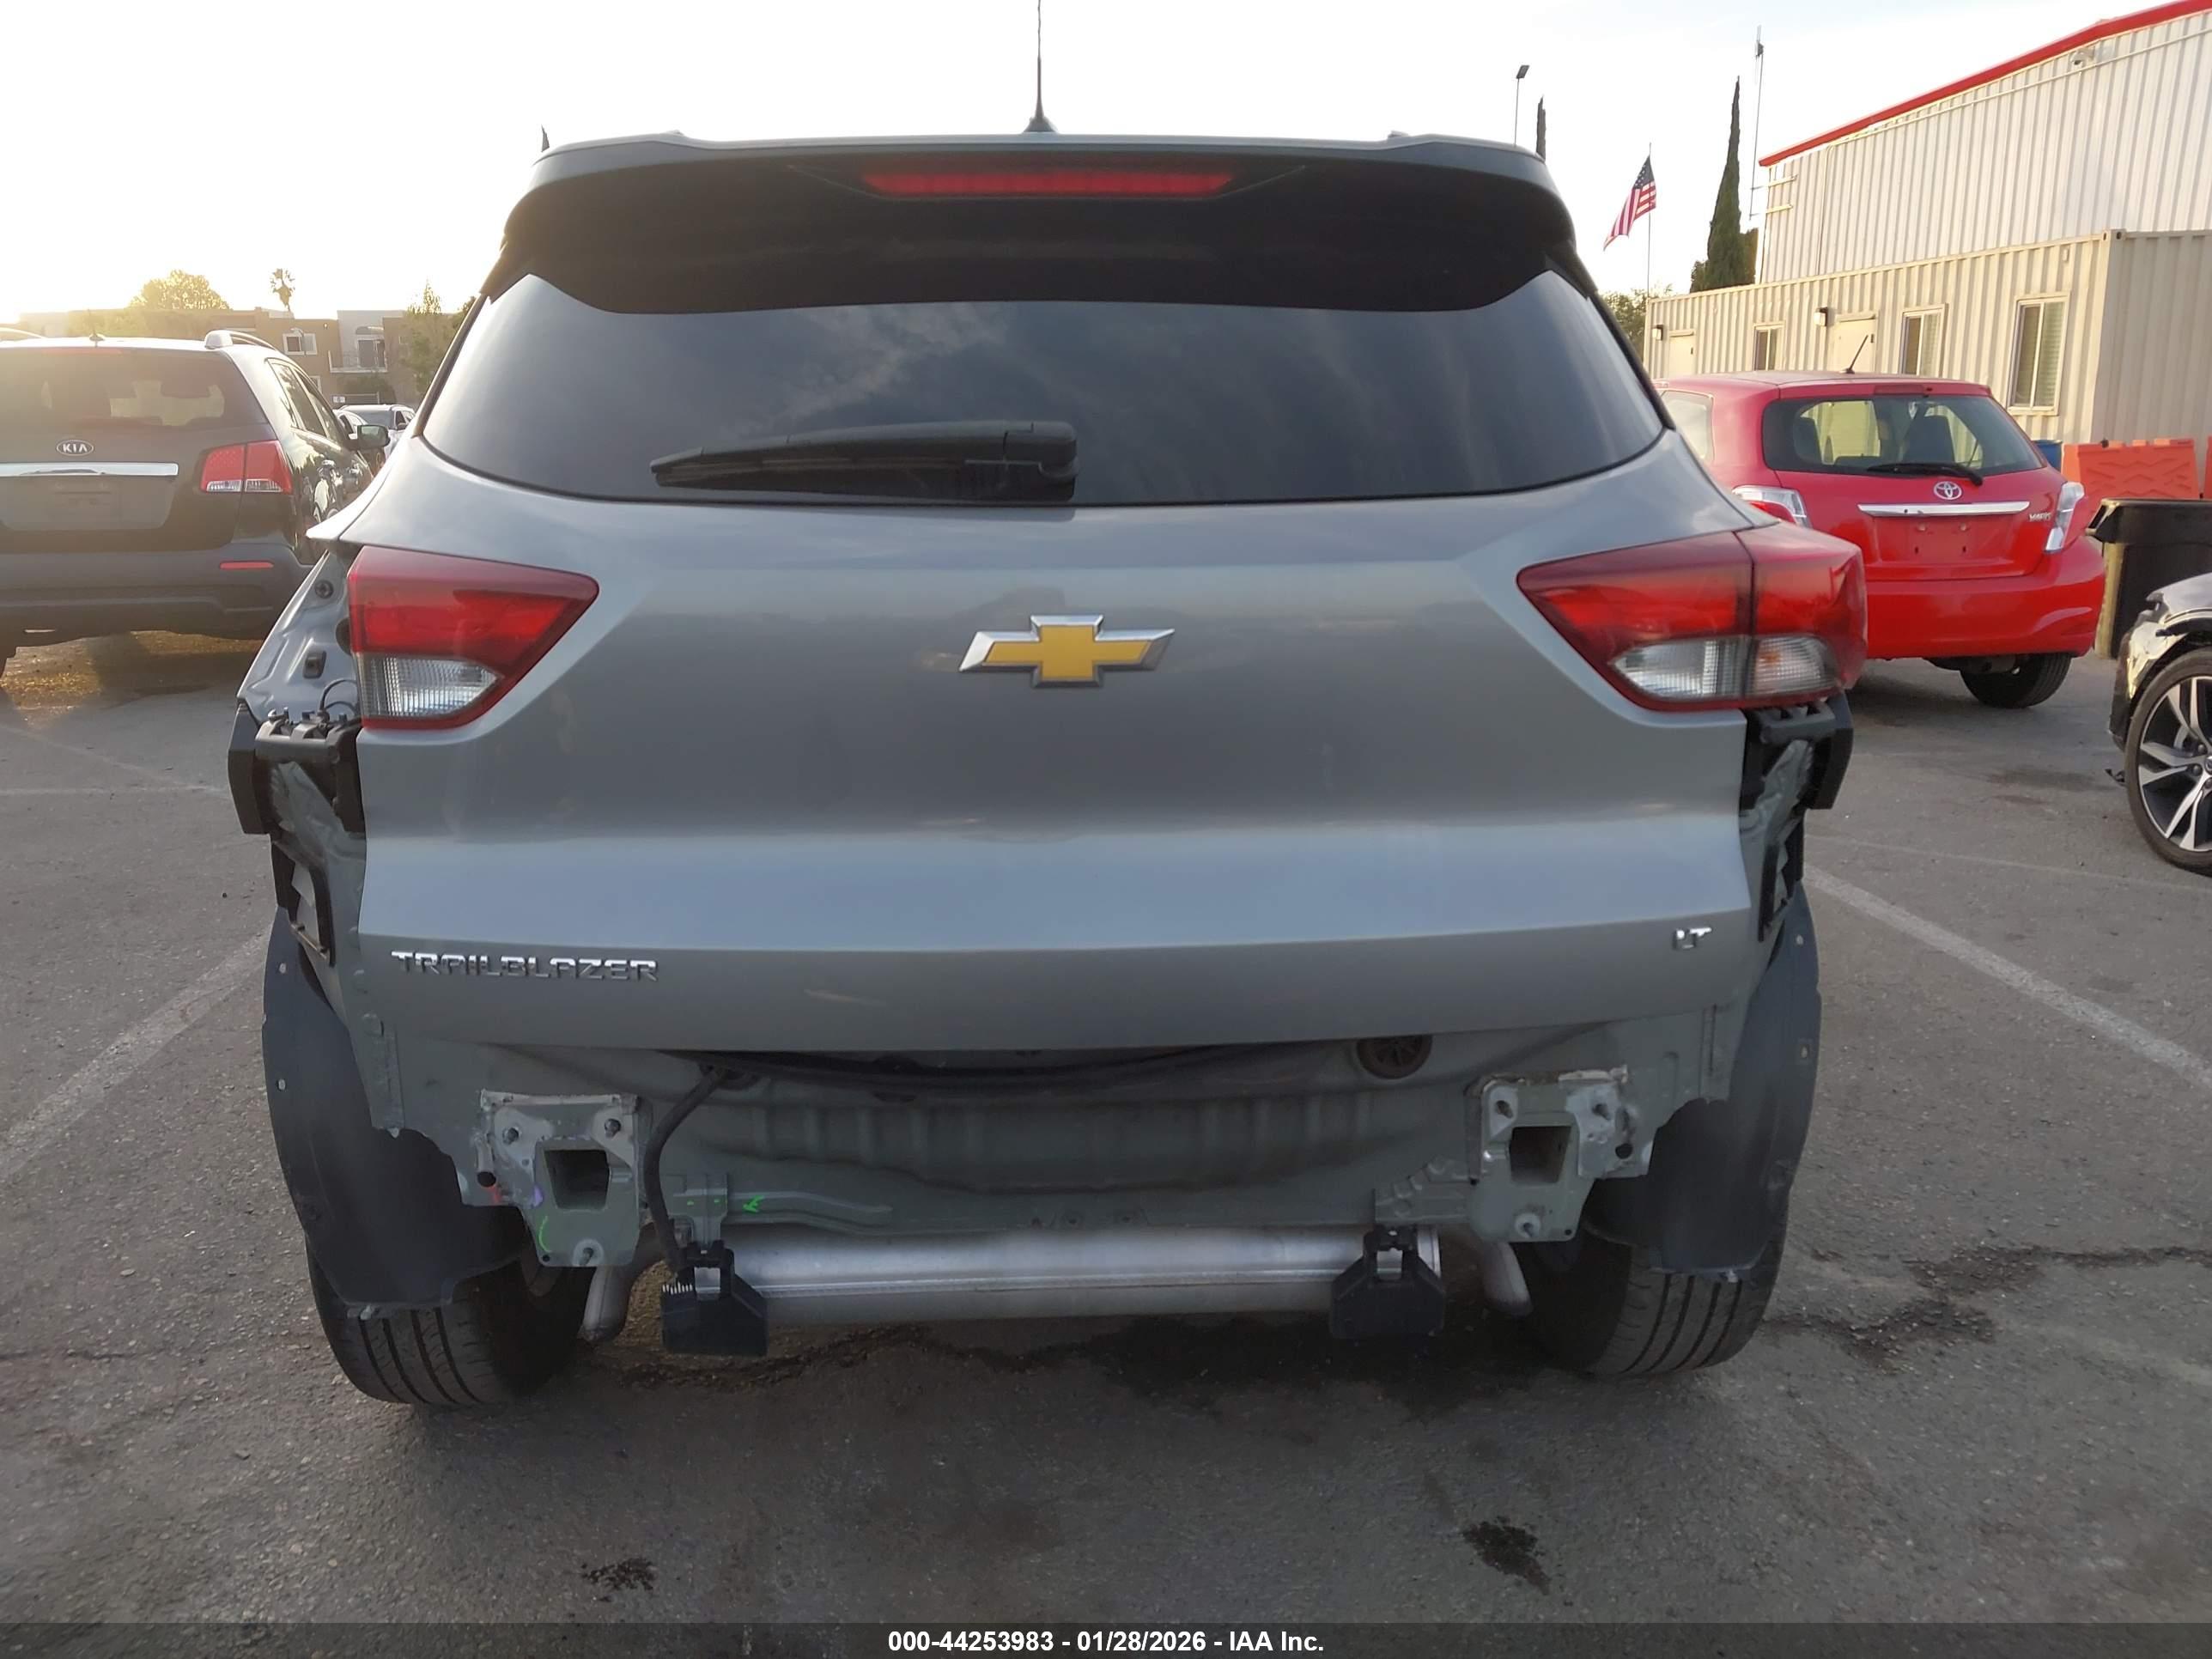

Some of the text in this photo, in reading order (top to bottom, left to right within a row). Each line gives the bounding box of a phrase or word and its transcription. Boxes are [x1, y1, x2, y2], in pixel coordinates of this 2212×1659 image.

[63, 443, 88, 453] KIA
[1674, 927, 1712, 949] LT
[391, 951, 659, 981] TRAILBLAZER
